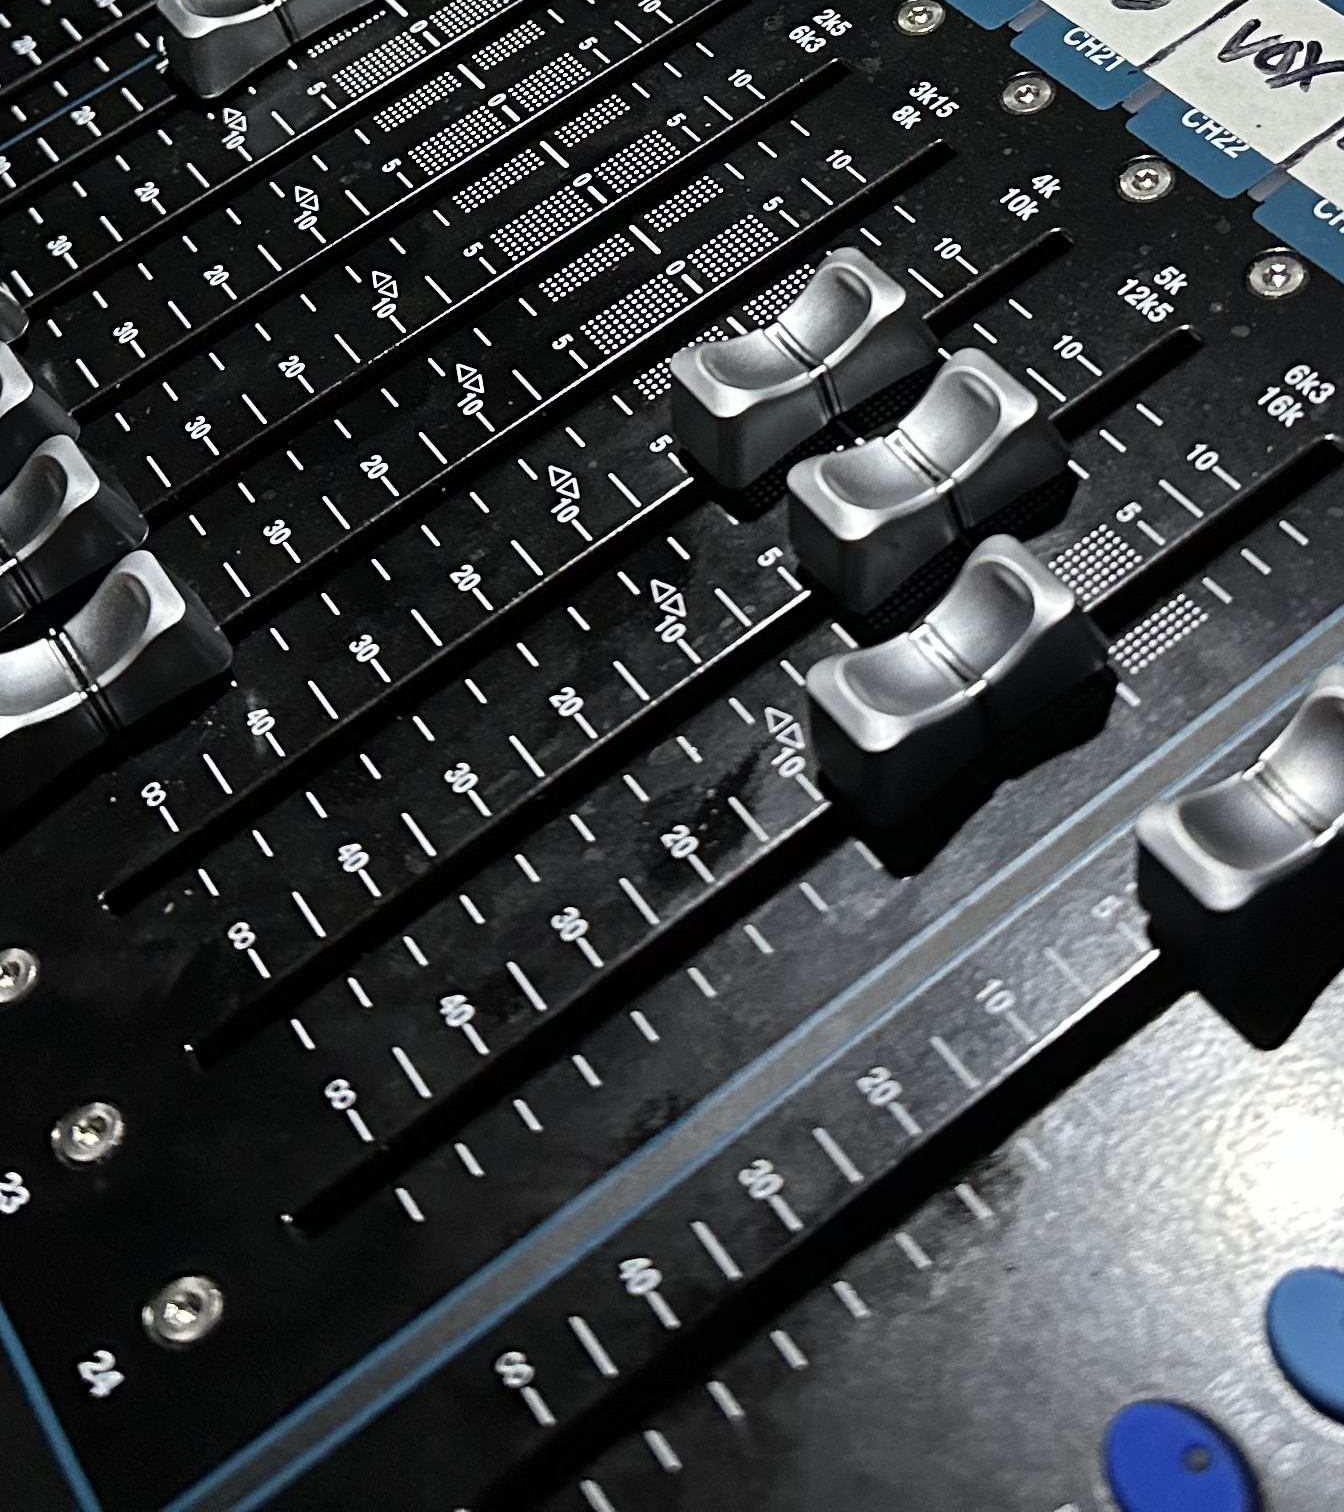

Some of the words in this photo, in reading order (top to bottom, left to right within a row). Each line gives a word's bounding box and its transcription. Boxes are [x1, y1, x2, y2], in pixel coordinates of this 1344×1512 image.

[408, 19, 429, 36] 0
[812, 8, 853, 37] 2k5
[578, 36, 598, 53] 5
[788, 25, 827, 55] 6k3
[1062, 25, 1124, 74] CH21
[306, 81, 327, 97] 5
[726, 68, 754, 89] 10
[487, 93, 508, 110] 0
[908, 80, 961, 120] 3k15
[666, 112, 687, 129] 5
[892, 105, 923, 130] 8k
[221, 131, 246, 151] 10
[1180, 107, 1255, 162] CH22
[381, 158, 403, 175] 5
[826, 148, 854, 172] 10
[572, 173, 593, 189] 0
[1031, 174, 1062, 201] 4k
[762, 195, 784, 214] 5
[999, 187, 1039, 223] 10k
[293, 210, 318, 231] 10
[463, 241, 484, 260] 5
[933, 235, 963, 260] 10
[203, 265, 230, 287] 20
[665, 259, 687, 276] 0
[1154, 266, 1189, 297] 5k
[371, 297, 398, 320] 10
[1117, 277, 1175, 324] 12k5
[551, 332, 573, 352] 5
[1052, 334, 1085, 361] 10
[277, 354, 306, 380] 20
[1284, 363, 1337, 406] 6k3
[456, 393, 484, 418] 10
[1256, 386, 1306, 430] 16k
[184, 414, 214, 440] 30
[650, 433, 674, 454] 5
[360, 454, 391, 480] 20
[1185, 444, 1219, 473] 10
[549, 497, 580, 524] 10
[1115, 501, 1142, 524] 5
[263, 517, 294, 546] 30
[756, 546, 784, 569] 5
[449, 564, 484, 593] 20
[655, 612, 689, 644] 10
[349, 633, 381, 664] 30
[549, 686, 586, 719] 20
[246, 707, 278, 736] 40
[771, 745, 808, 780] 10
[443, 761, 481, 795] 30
[660, 824, 700, 861] 20
[336, 842, 372, 874] 40
[550, 905, 592, 944] 30
[975, 977, 1016, 1014] 10
[438, 993, 477, 1029] 40
[856, 1067, 904, 1106] 20
[738, 1159, 785, 1201] 30
[617, 1257, 663, 1297] 40
[76, 1348, 125, 1398] 24
